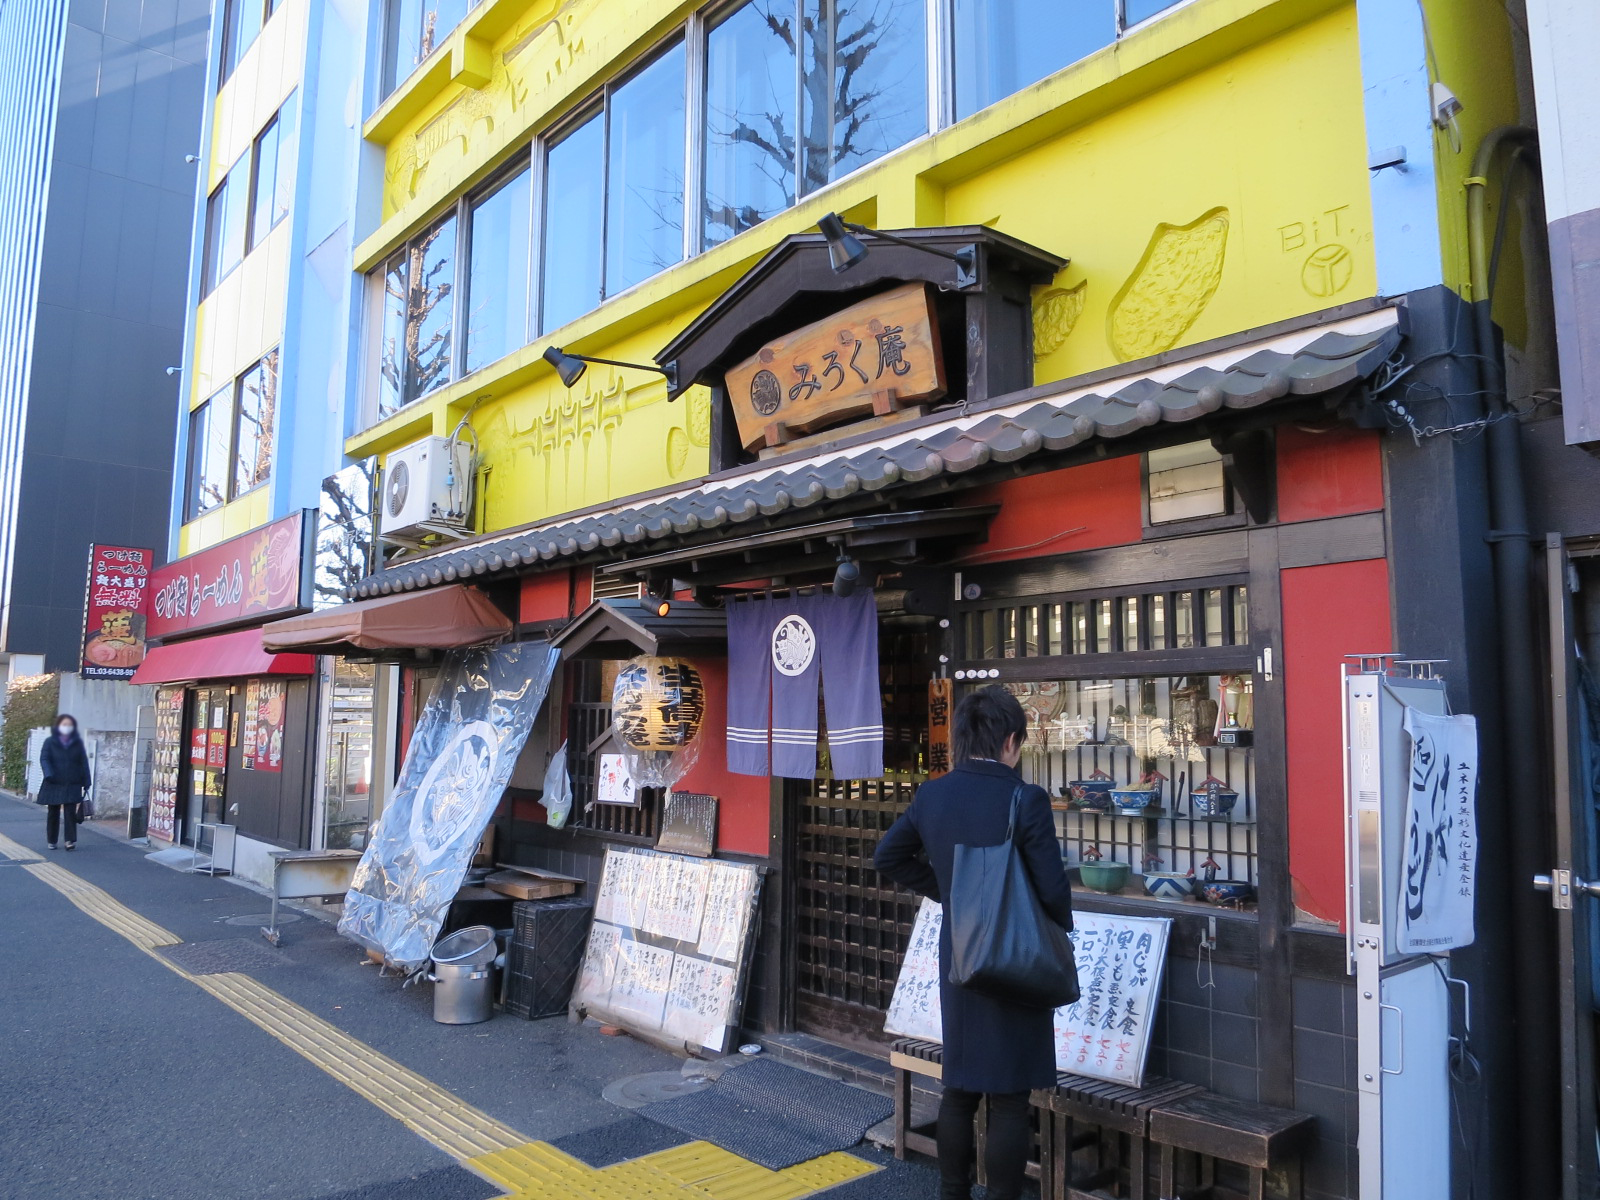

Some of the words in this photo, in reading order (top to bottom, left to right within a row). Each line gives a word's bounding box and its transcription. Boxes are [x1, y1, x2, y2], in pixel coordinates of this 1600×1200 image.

[789, 325, 911, 402] みろく庵
[102, 550, 142, 563] つけ麺
[97, 562, 147, 576] らーめん
[96, 575, 146, 588] 麺大盛り
[155, 575, 188, 618] つけ麺
[190, 559, 243, 617] らーめん
[95, 586, 141, 609] 無料
